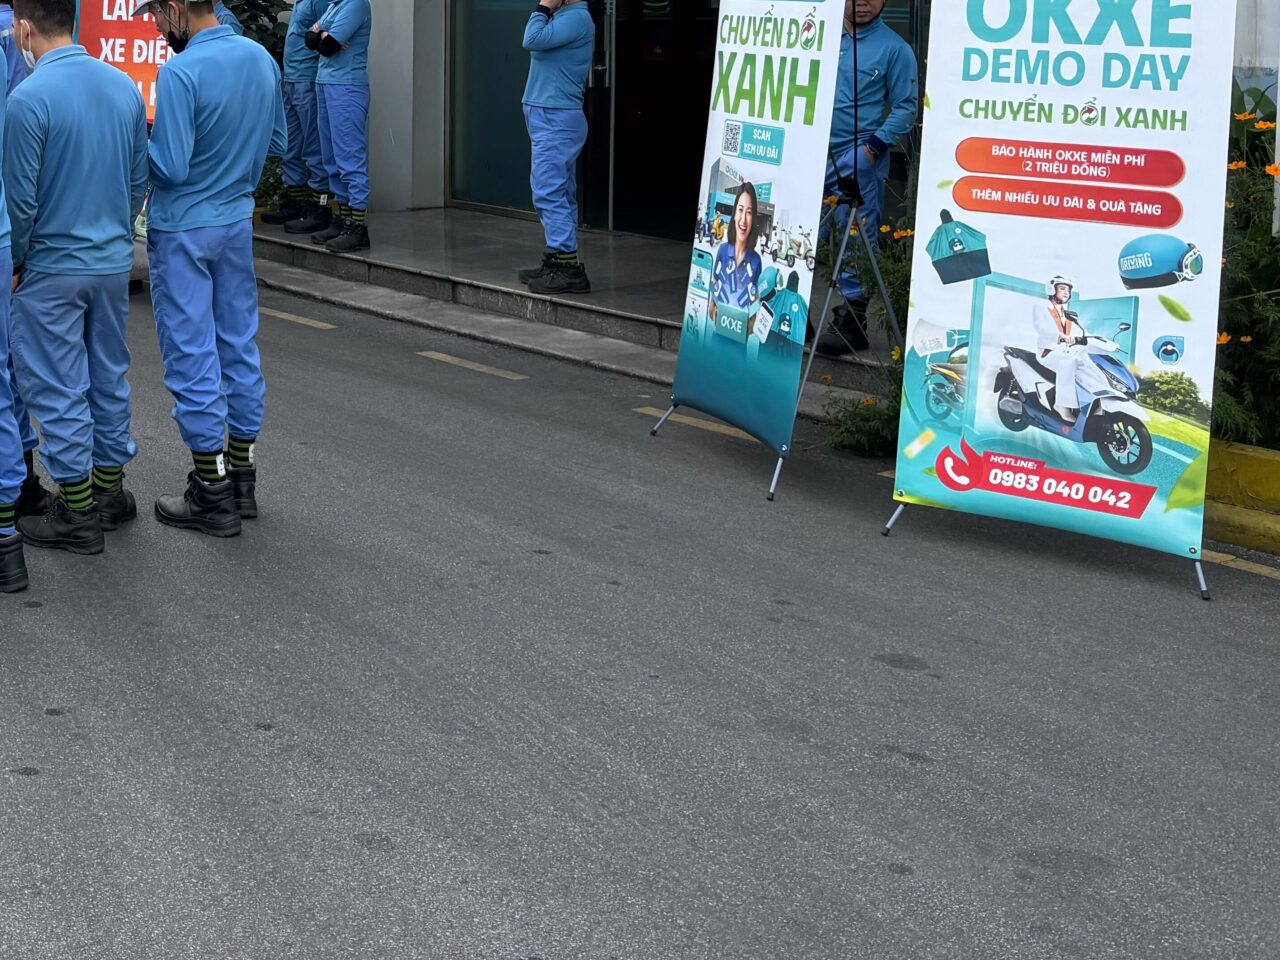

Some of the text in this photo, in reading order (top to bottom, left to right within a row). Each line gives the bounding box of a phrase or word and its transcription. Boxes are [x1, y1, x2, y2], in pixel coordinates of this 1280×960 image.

[719, 3, 786, 49] CHUYỂN
[99, 37, 127, 63] XE
[961, 47, 1191, 92] DEMO DAY
[711, 50, 821, 126] XANH
[958, 94, 1054, 124] CHUYỂN
[1114, 107, 1188, 132] XANH
[753, 128, 771, 141] SCAN
[1055, 150, 1088, 162] OKXE
[971, 188, 1002, 201] THÊM
[1086, 198, 1096, 209] &
[720, 315, 743, 334] OKXE
[989, 454, 1038, 470] HOTLINE:
[988, 468, 1132, 509] 0983 040 042
